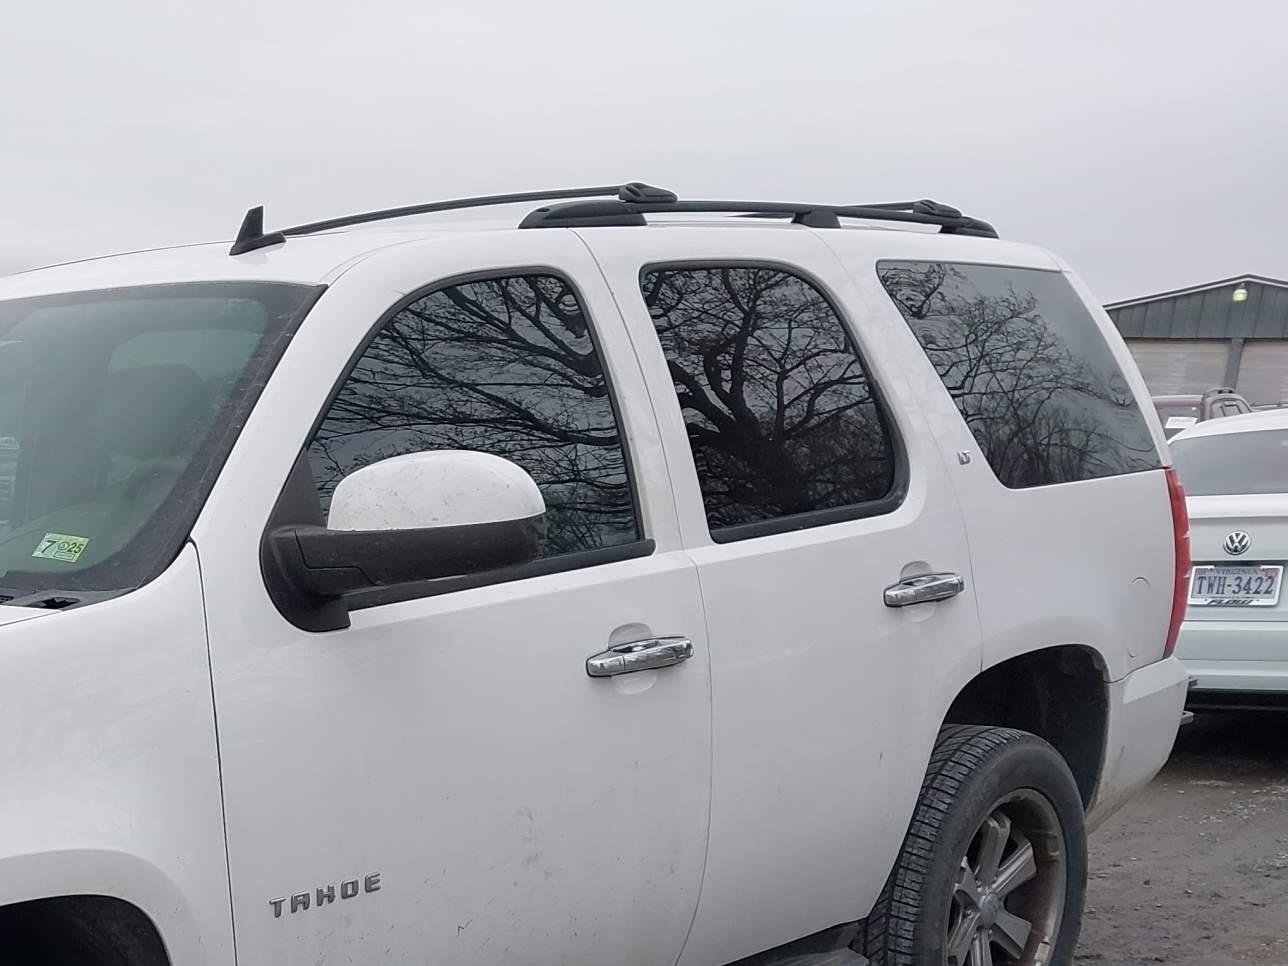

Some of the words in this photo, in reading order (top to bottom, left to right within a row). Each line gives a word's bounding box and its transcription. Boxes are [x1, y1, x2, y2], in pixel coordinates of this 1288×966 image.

[41, 539, 58, 554] 7
[67, 542, 85, 554] 25
[1196, 576, 1275, 595] TWH-3422
[269, 871, 381, 919] TAHOE
